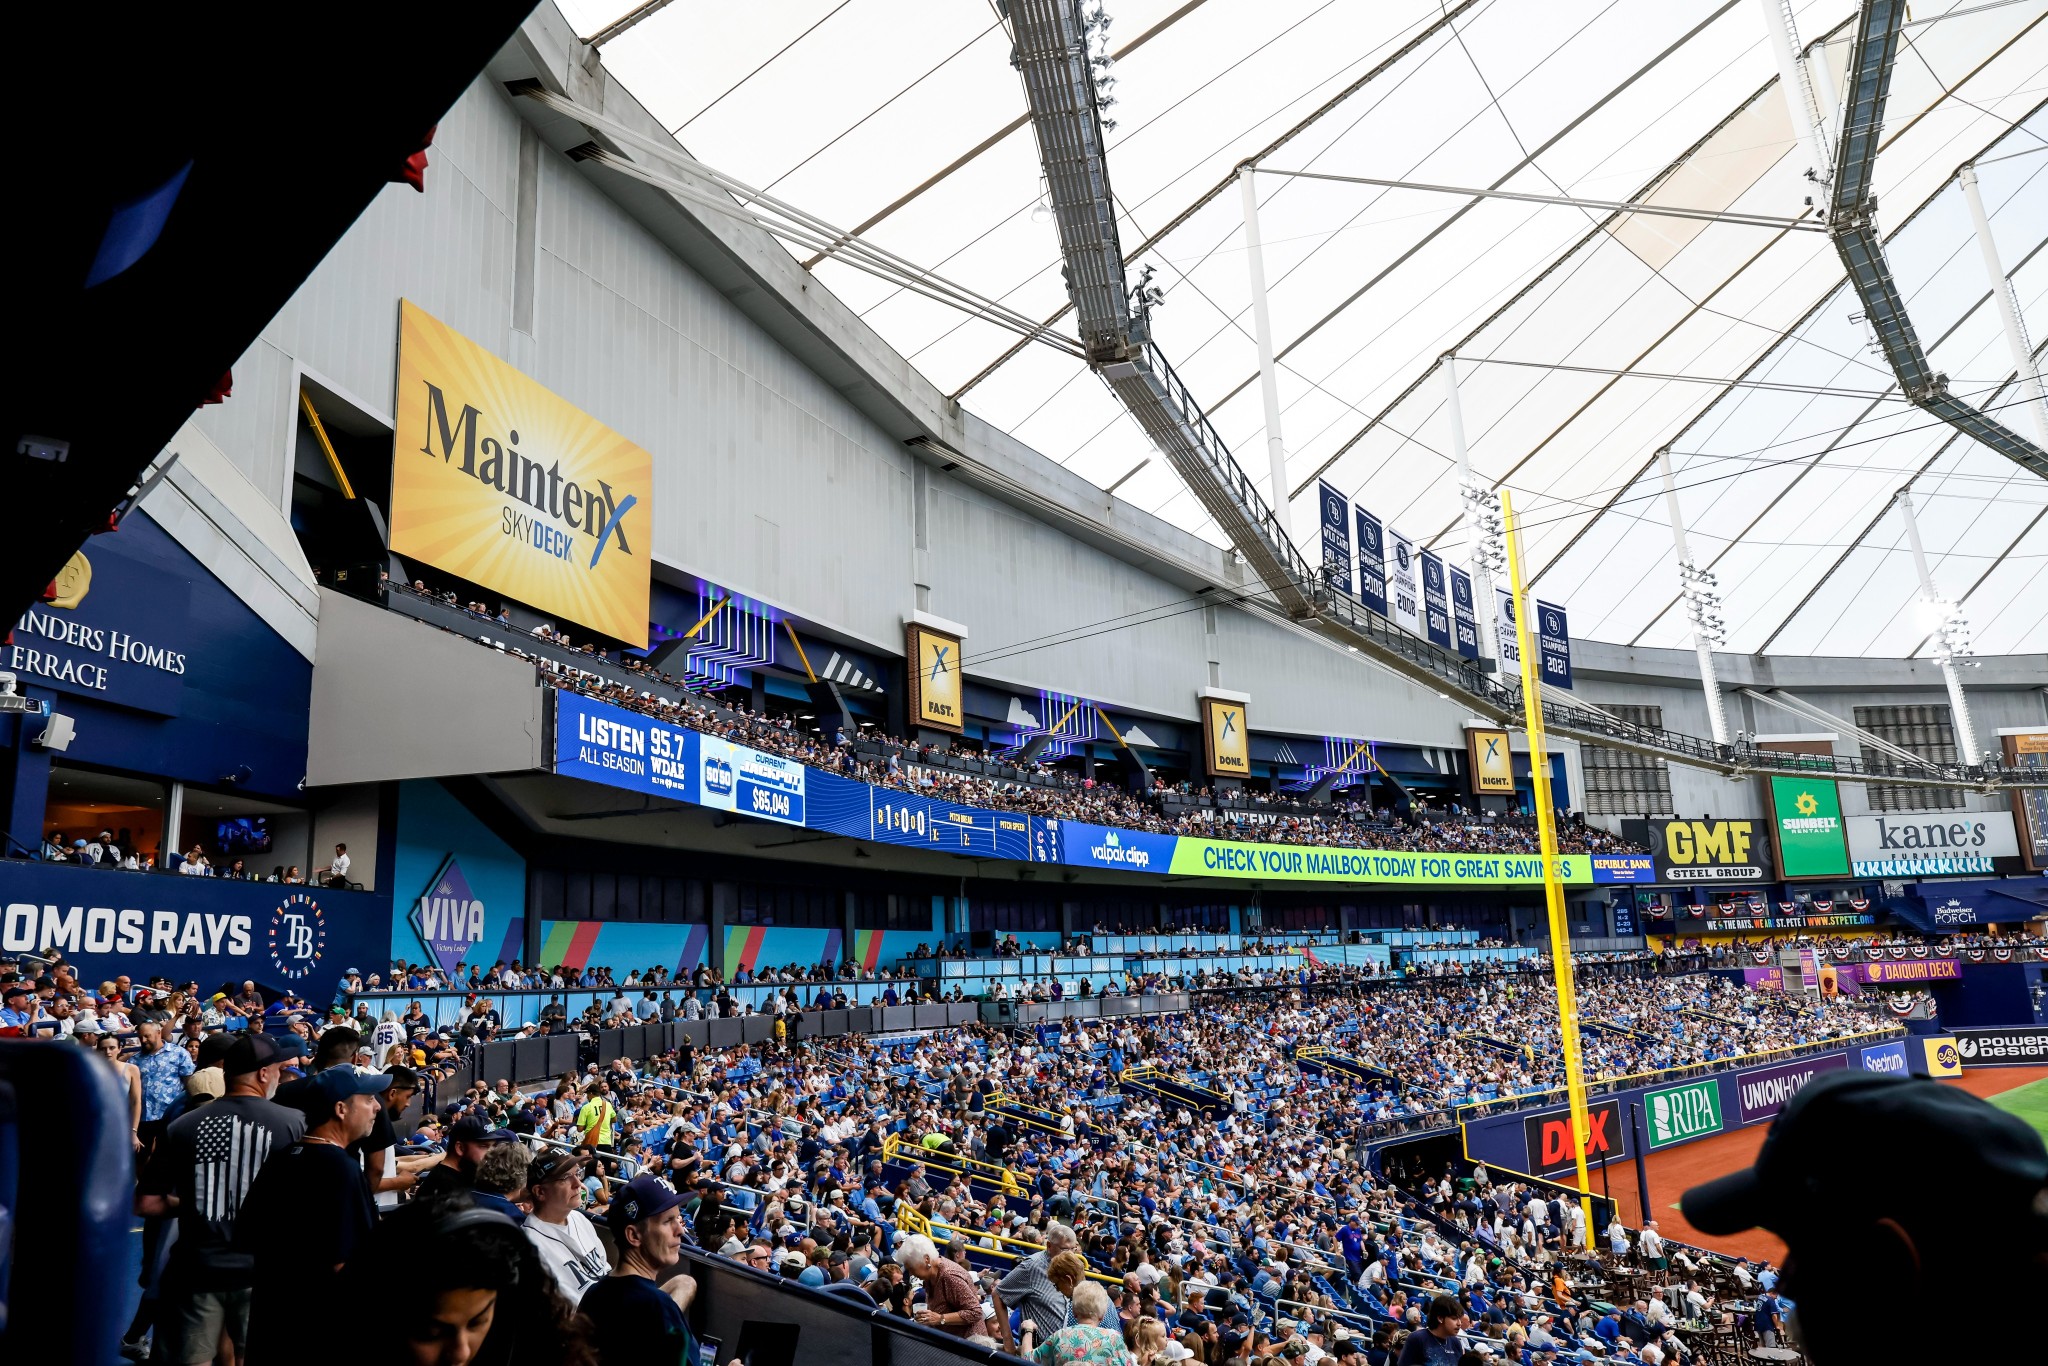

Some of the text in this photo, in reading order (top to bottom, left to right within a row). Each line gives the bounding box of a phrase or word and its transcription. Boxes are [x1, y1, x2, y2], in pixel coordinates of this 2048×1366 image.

[419, 379, 637, 570] MaintenX
[502, 506, 573, 563] SKYDECK
[1364, 572, 1384, 599] 2008
[1397, 592, 1416, 617] 2008
[1429, 610, 1447, 633] 2010
[1459, 624, 1475, 646] 2020
[0, 645, 108, 690] ERRACE
[1547, 656, 1567, 675] 2021
[928, 701, 954, 717] FAST.
[579, 712, 684, 760] LISTEN 95.7
[579, 746, 645, 776] ALL SEASON
[650, 756, 685, 780] WDAE
[755, 754, 787, 769] CURRENT
[1219, 756, 1244, 767] DONE.
[740, 760, 801, 791] JACKPOT
[1482, 777, 1509, 786] RIGHT.
[753, 786, 790, 816] $65,049
[878, 809, 884, 824] B
[885, 804, 891, 830] 1
[894, 812, 900, 827] S
[901, 807, 909, 833] 0
[917, 810, 925, 836] 0
[1051, 832, 1056, 845] 3
[1665, 821, 1752, 865] GMF
[1875, 817, 1986, 850] kane's
[1051, 847, 1057, 861] 3
[1091, 843, 1126, 865] valpak
[1203, 846, 1257, 872] CHECK
[1258, 851, 1303, 873] YOUR
[1306, 853, 1372, 876] MAILBOX
[1373, 856, 1417, 877] TODAY
[1421, 858, 1451, 878] FOR
[1454, 859, 1500, 879] GREAT
[1593, 859, 1651, 869] REPUBLIC BANK
[1891, 850, 1981, 861] FURNITURE
[1673, 868, 1756, 878] STEEL GROUP
[421, 896, 485, 942] VIVA
[1706, 920, 1717, 930] WE
[1724, 919, 1736, 930] THE
[1753, 919, 1764, 928] WE
[1807, 915, 1875, 927] WWW.STPETE.ORG
[1935, 913, 1977, 924] PORCH
[0, 903, 313, 959] OMOS RAYS TB
[1885, 961, 1956, 980] DAIQUIRI DECK
[377, 1031, 393, 1045] 85
[1669, 1087, 1717, 1137] RIPA
